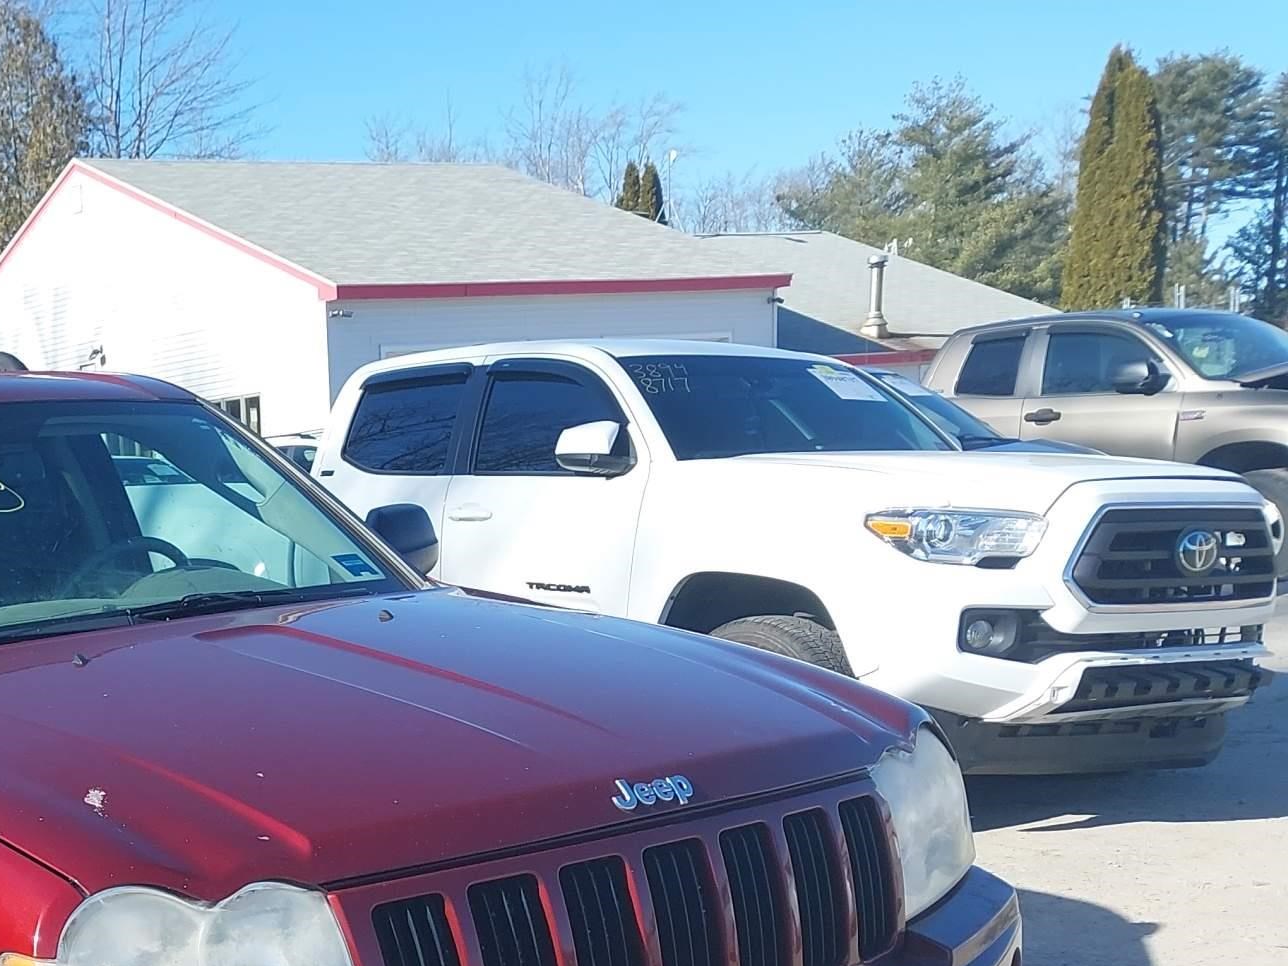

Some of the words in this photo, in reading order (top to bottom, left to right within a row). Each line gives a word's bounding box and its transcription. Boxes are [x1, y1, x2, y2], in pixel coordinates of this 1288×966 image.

[640, 377, 691, 394] 8717
[525, 582, 591, 594] TACOMA
[611, 775, 694, 811] Jeep
